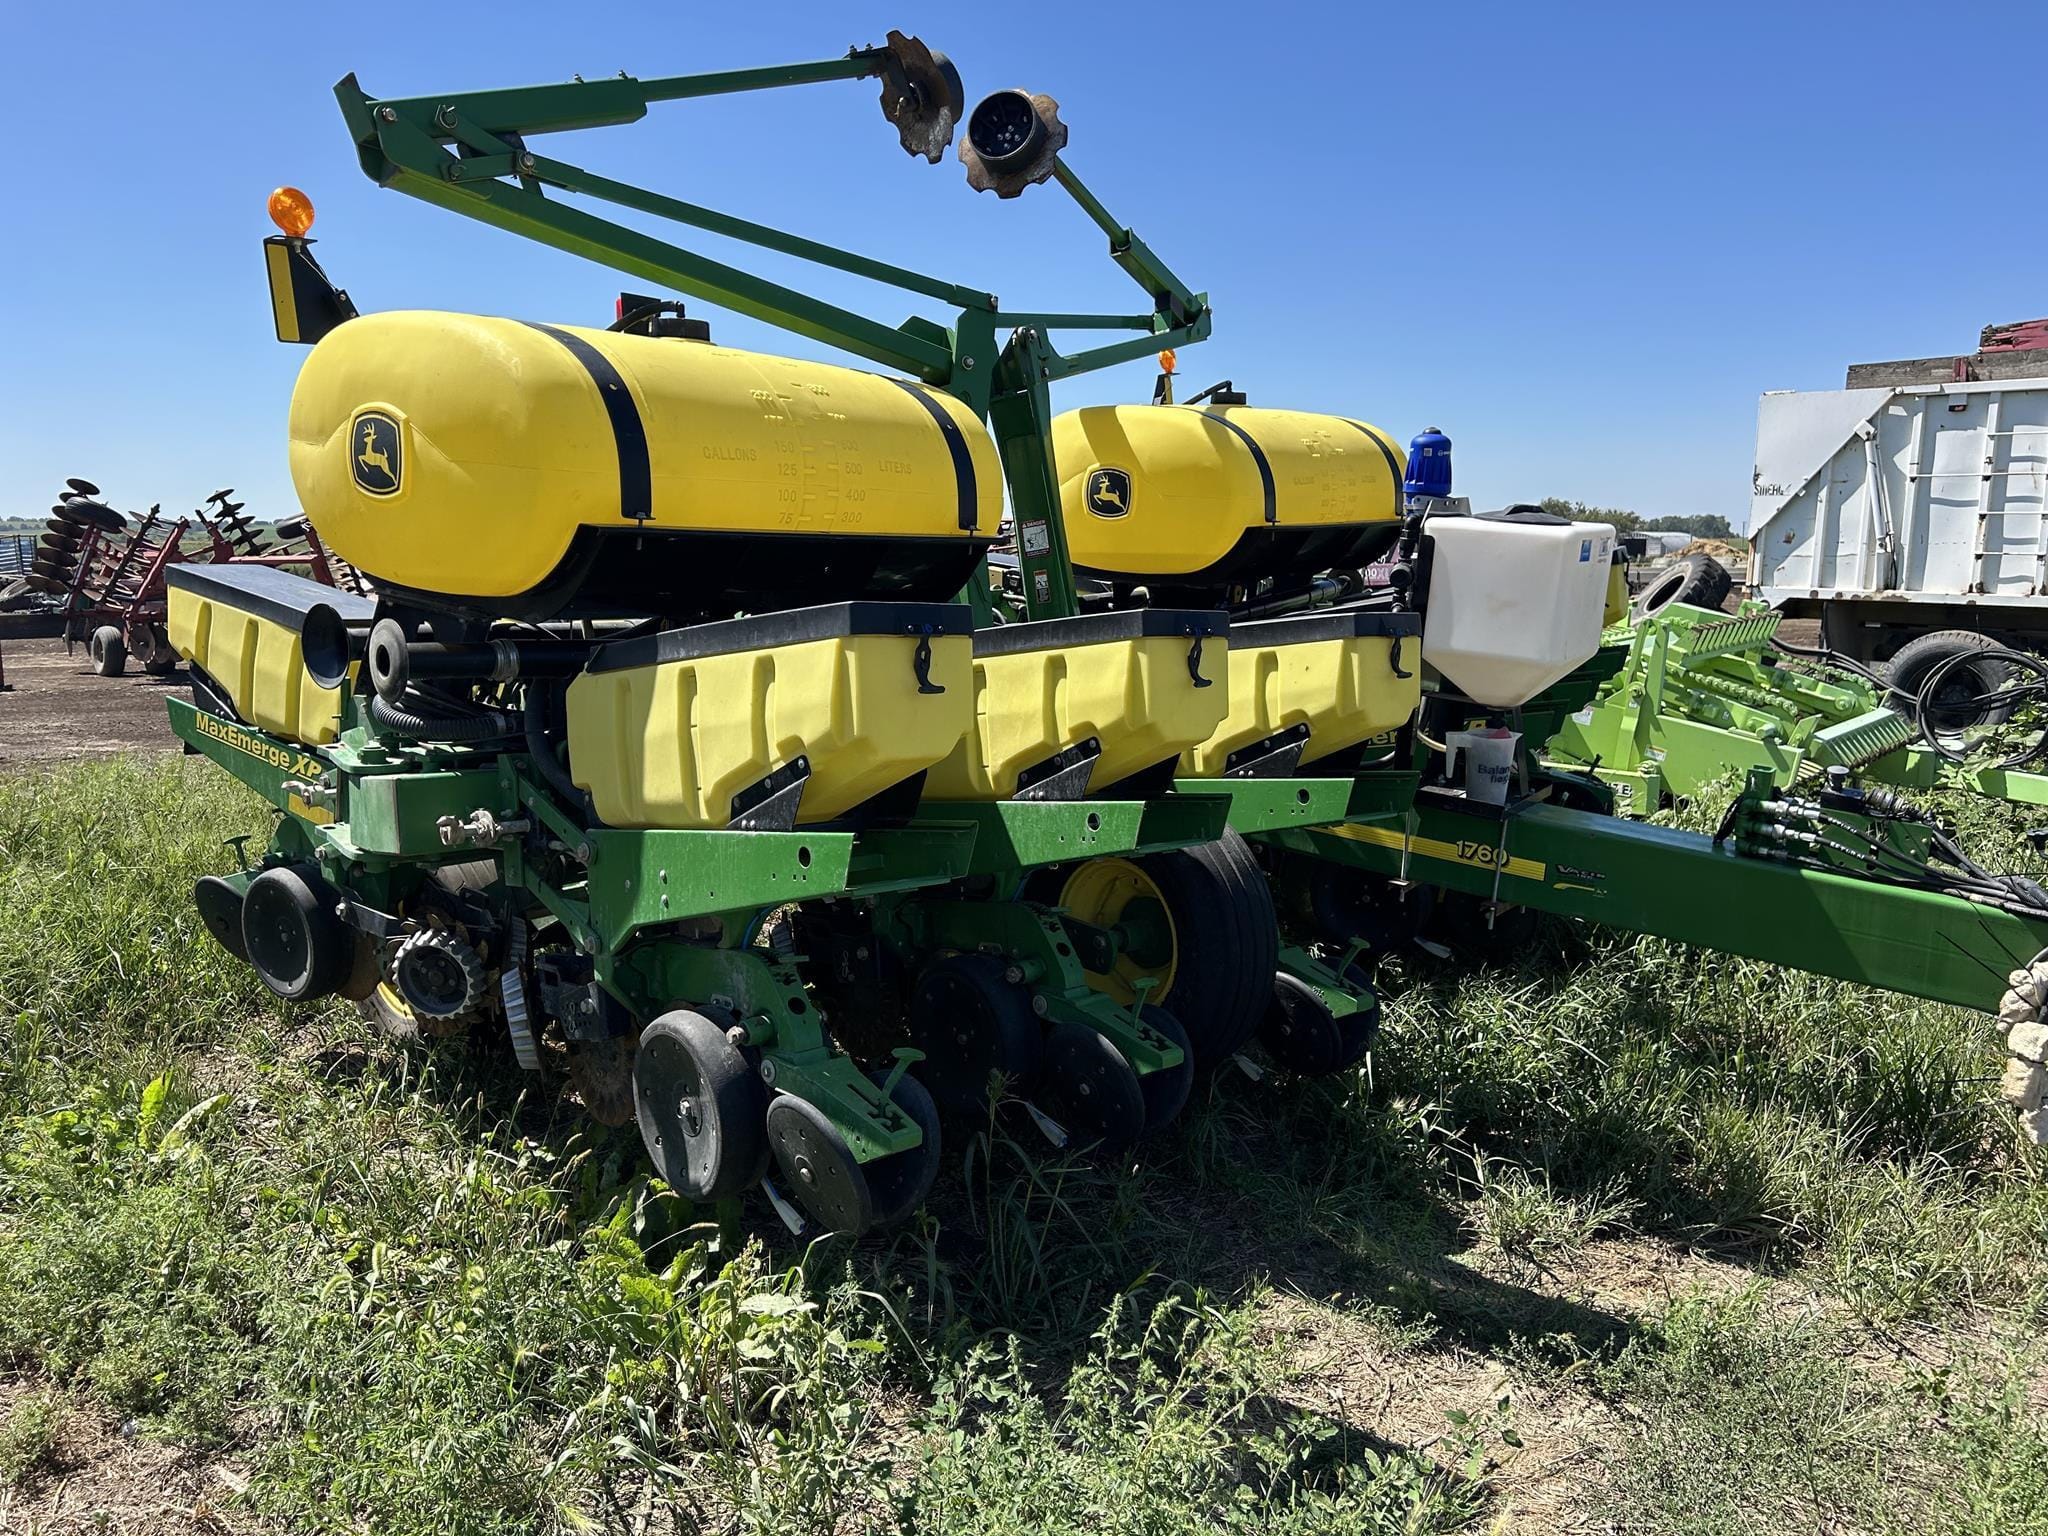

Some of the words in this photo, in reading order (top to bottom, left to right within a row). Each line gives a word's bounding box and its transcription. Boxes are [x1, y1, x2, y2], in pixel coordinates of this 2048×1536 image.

[703, 446, 757, 461] GALLONS
[777, 463, 798, 476] 125
[879, 460, 912, 474] LITERS
[777, 488, 797, 502] 100
[846, 490, 866, 502] 400
[778, 513, 792, 524] 75
[195, 711, 290, 767] MaxEmerge
[287, 755, 322, 779] XP
[1456, 839, 1508, 865] 1760
